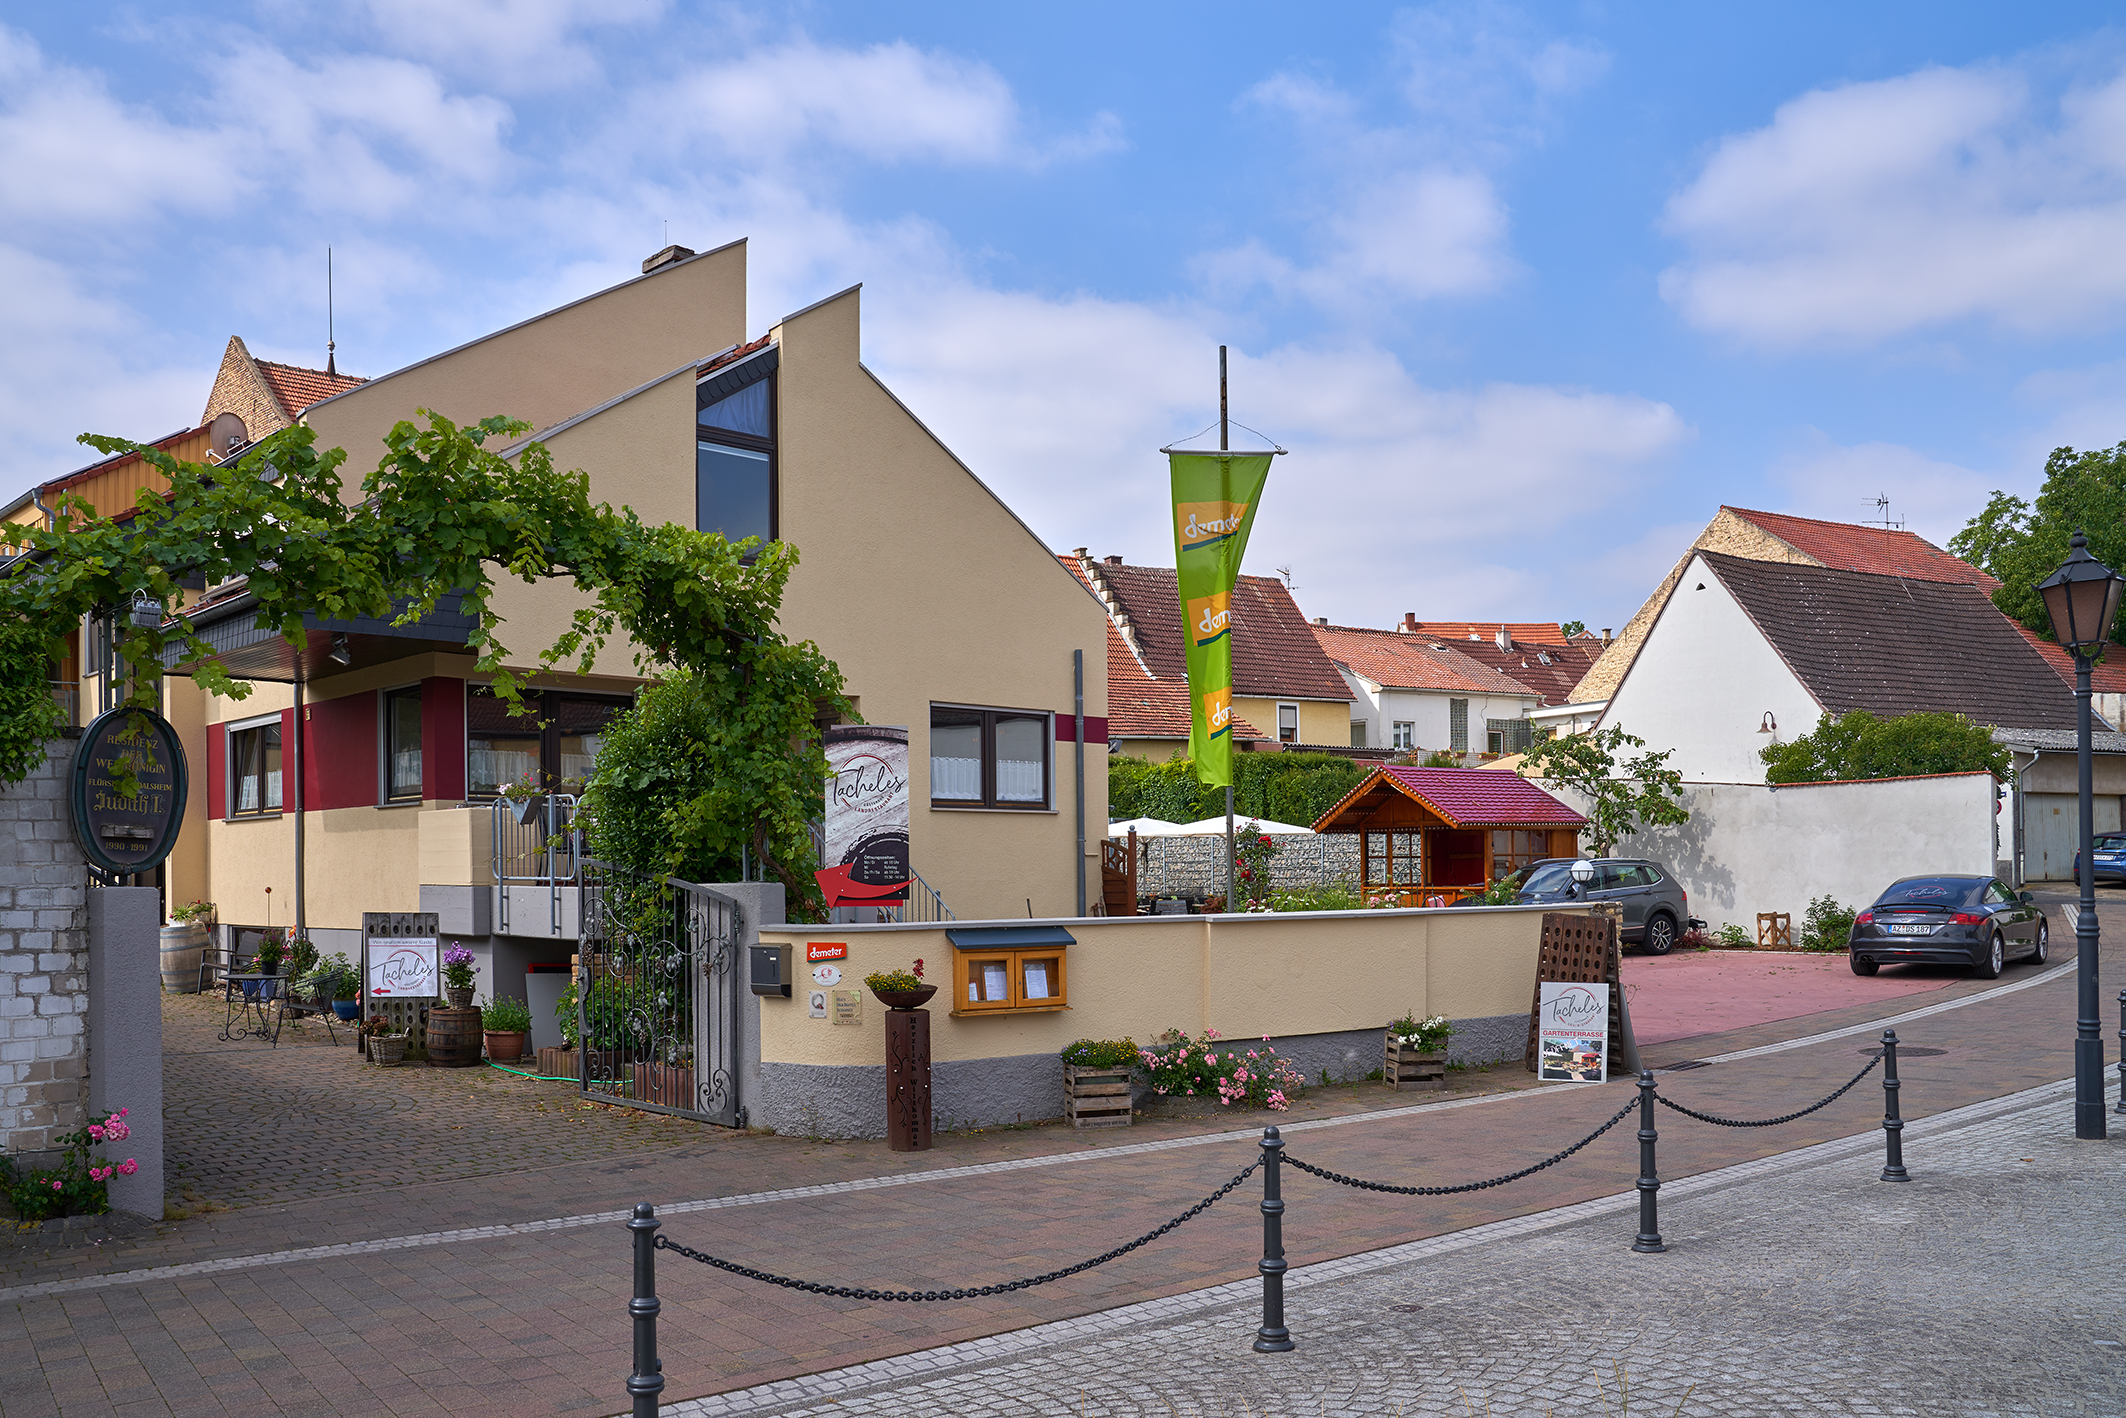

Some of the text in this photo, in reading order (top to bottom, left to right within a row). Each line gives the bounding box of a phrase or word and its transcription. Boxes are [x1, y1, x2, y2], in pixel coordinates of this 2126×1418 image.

[107, 734, 159, 749] RESIDENZ
[122, 749, 143, 760] DER
[825, 765, 907, 807] Tacheles
[854, 791, 894, 813] LANDRESTAURANT
[105, 842, 125, 850] 1990
[130, 843, 148, 852] 1991
[1892, 925, 1930, 934] AZ DS 187
[809, 946, 843, 959] demeter
[370, 957, 436, 986] Tacheles
[1543, 994, 1605, 1022] Tacheles
[1542, 1029, 1604, 1038] GARTENTERRASSE
[909, 1017, 919, 1147] Herzlich Willkommen
